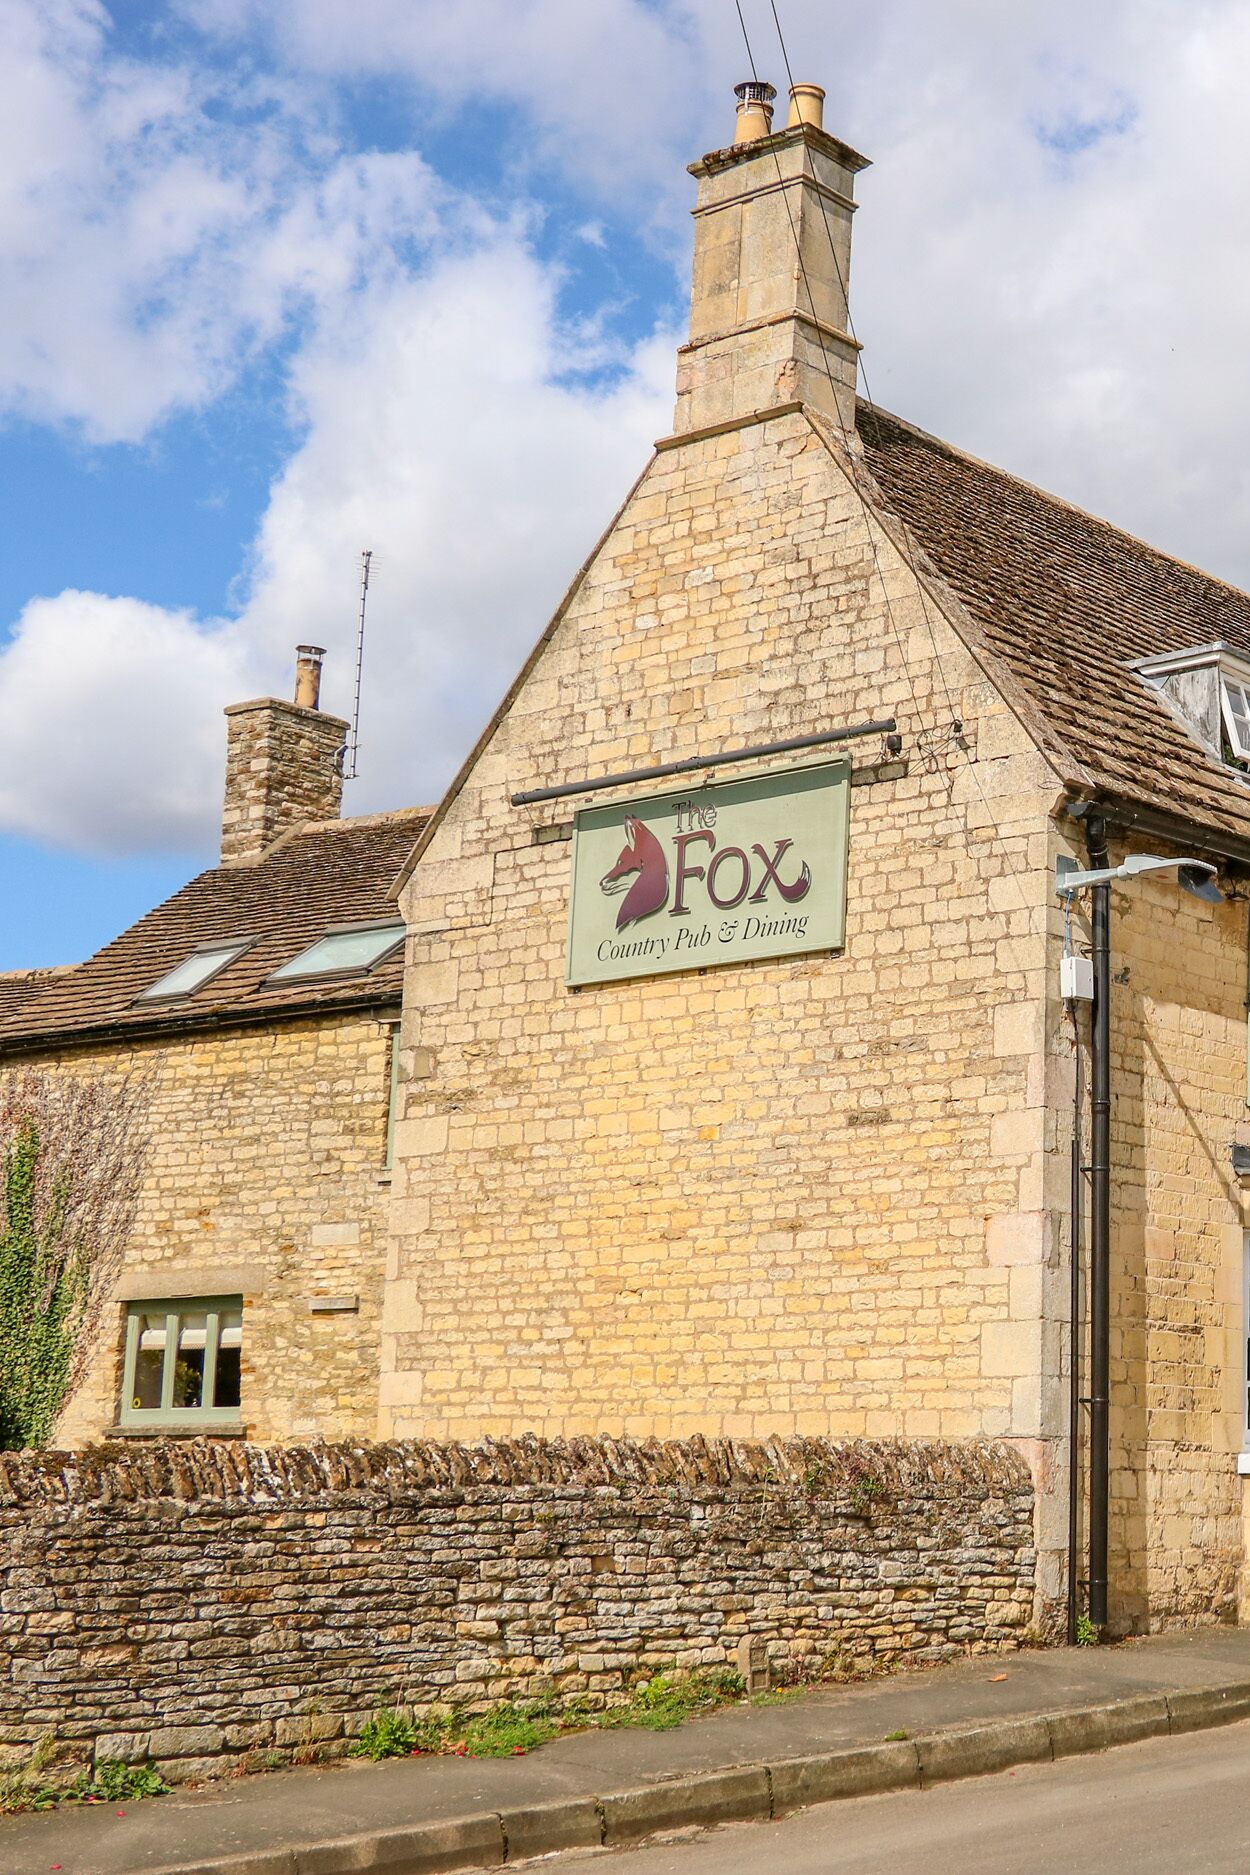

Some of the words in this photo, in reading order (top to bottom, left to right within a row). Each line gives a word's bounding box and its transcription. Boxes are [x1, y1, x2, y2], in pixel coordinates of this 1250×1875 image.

[671, 800, 717, 833] The
[597, 936, 670, 962] Country
[674, 924, 711, 950] Pub
[718, 919, 739, 943] &
[742, 911, 810, 939] Dining
